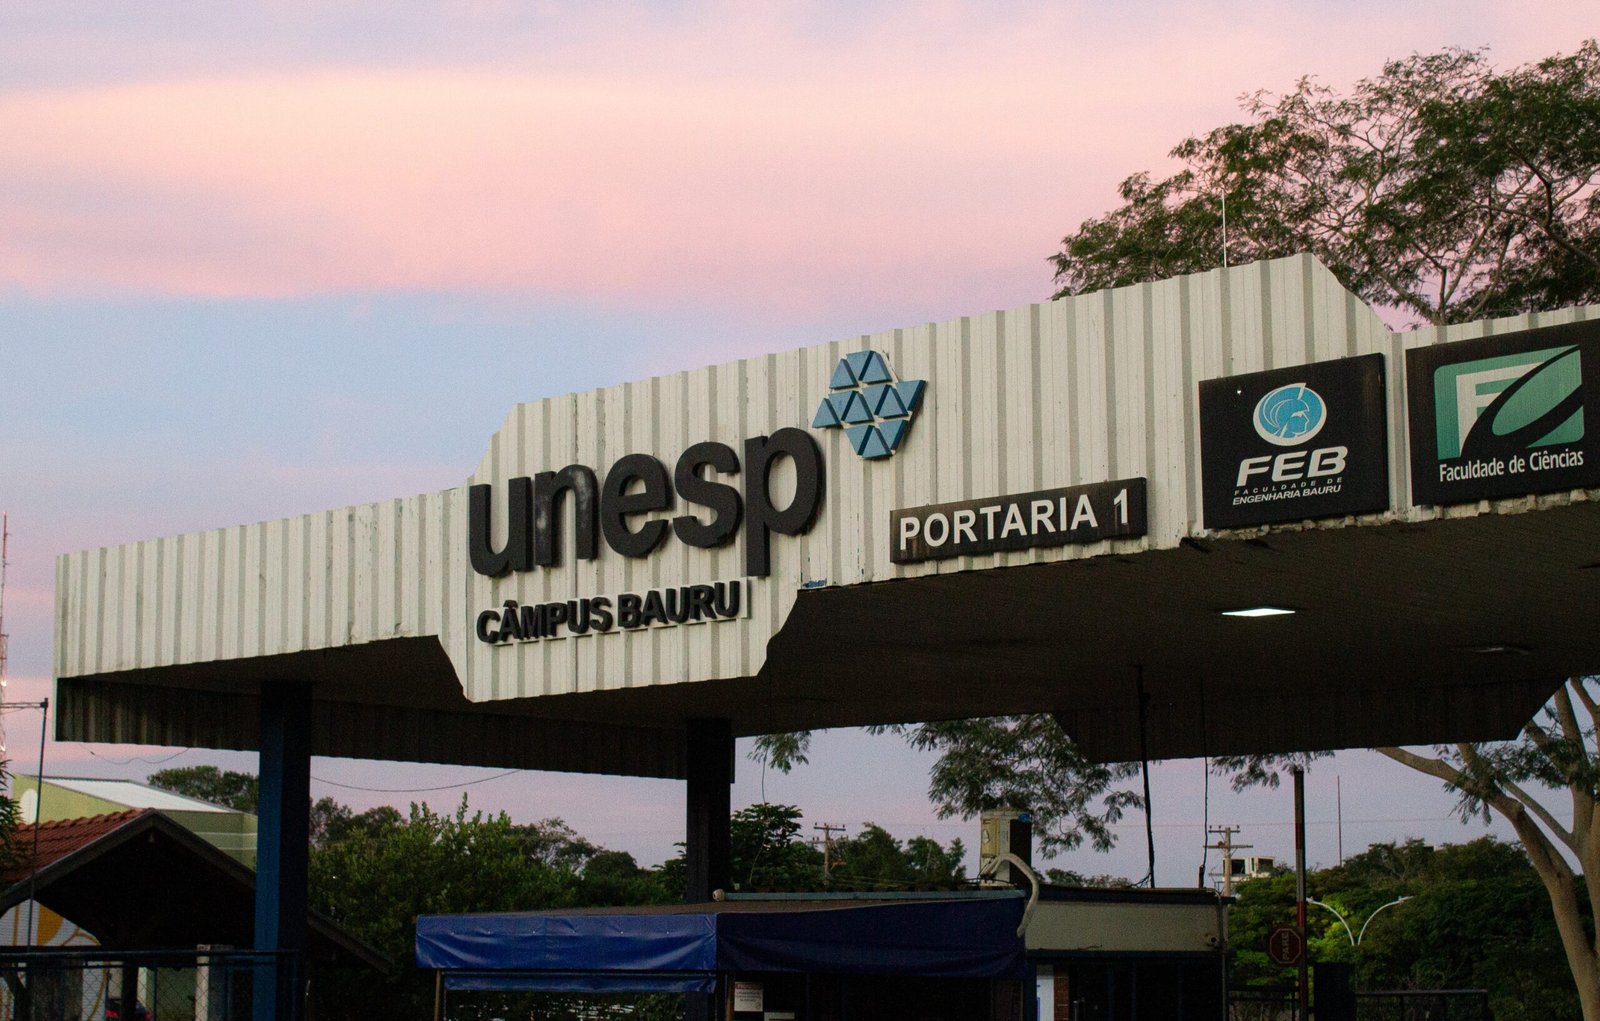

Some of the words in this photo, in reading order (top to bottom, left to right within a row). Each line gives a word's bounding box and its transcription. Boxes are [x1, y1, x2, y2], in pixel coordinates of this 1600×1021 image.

[1236, 445, 1348, 487] FEB
[1439, 457, 1505, 482] Faculdade
[1508, 455, 1525, 474] de
[1529, 448, 1584, 471] Ciências
[469, 427, 825, 577] unesp
[1232, 489, 1301, 506] ENGENHARIA
[1302, 485, 1342, 497] BAURU
[1234, 480, 1317, 496] FACULDADE
[1327, 477, 1343, 485] DE
[900, 494, 1098, 551] PORTARIA
[1113, 488, 1128, 524] 1
[476, 600, 613, 643] CÂMPUS
[617, 581, 740, 628] BAURU
[1281, 932, 1290, 961] PARE
